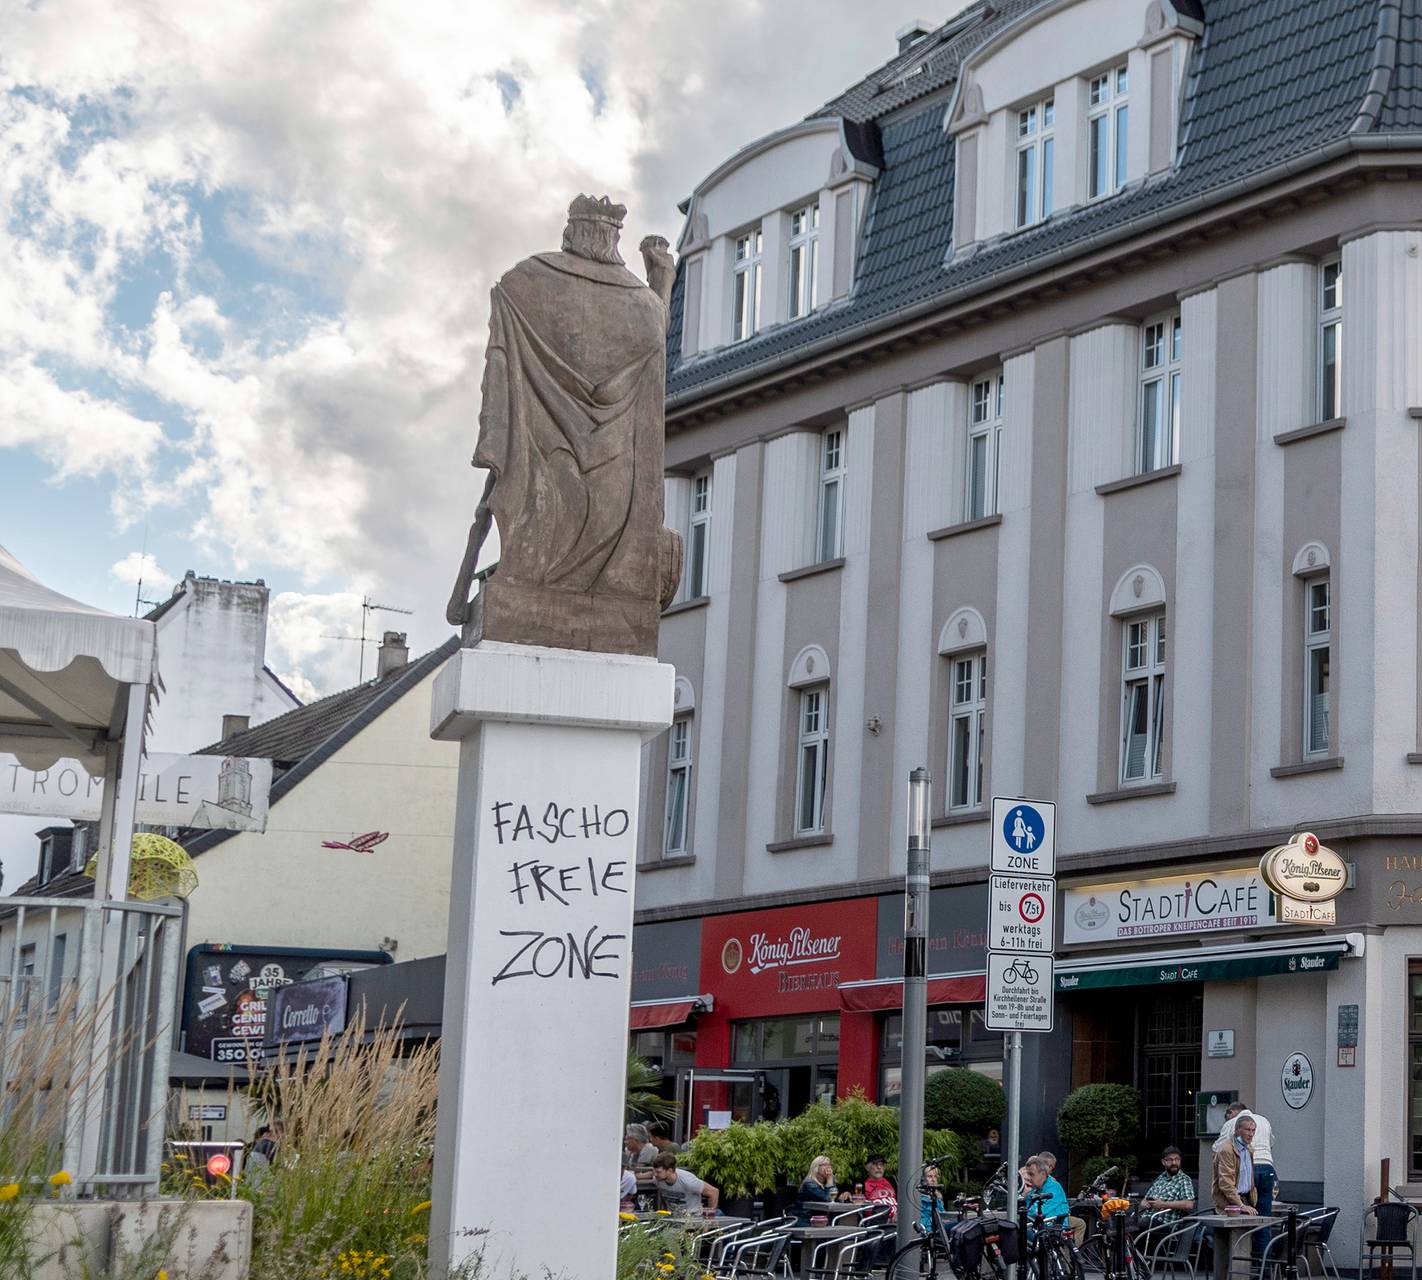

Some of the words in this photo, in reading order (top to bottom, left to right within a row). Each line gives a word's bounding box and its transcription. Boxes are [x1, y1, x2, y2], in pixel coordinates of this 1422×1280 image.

[491, 802, 630, 845] FASCHO
[1007, 856, 1039, 870] ZONE
[1281, 858, 1310, 878] König
[1309, 860, 1341, 877] Pilsener
[507, 857, 628, 906] FREIE
[994, 878, 1051, 892] Lieferverkehr
[999, 901, 1012, 912] bis
[1002, 924, 1041, 938] werktags
[1119, 927, 1132, 936] DAS
[1133, 924, 1172, 935] BOTTROPER
[1222, 918, 1238, 927] SEIT
[1240, 915, 1257, 925] 1919
[747, 933, 789, 966] König
[787, 927, 841, 959] Pilsener
[1028, 938, 1043, 949] frei
[491, 925, 626, 986] ZONE
[1300, 955, 1325, 970] Stauder
[264, 967, 279, 977] 35
[778, 971, 840, 993] BIERHAUS
[1001, 986, 1030, 995] Durchfahrt
[1031, 987, 1039, 995] bis
[993, 994, 1029, 1003] Kirchhellener
[1025, 1004, 1035, 1012] und
[282, 1004, 319, 1029] Corretto
[992, 1010, 1008, 1019] Sonn-
[1009, 1011, 1019, 1019] und
[1020, 1011, 1048, 1022] Feiertagen
[1015, 1020, 1025, 1028] frei
[1284, 1076, 1310, 1091] Stauder
